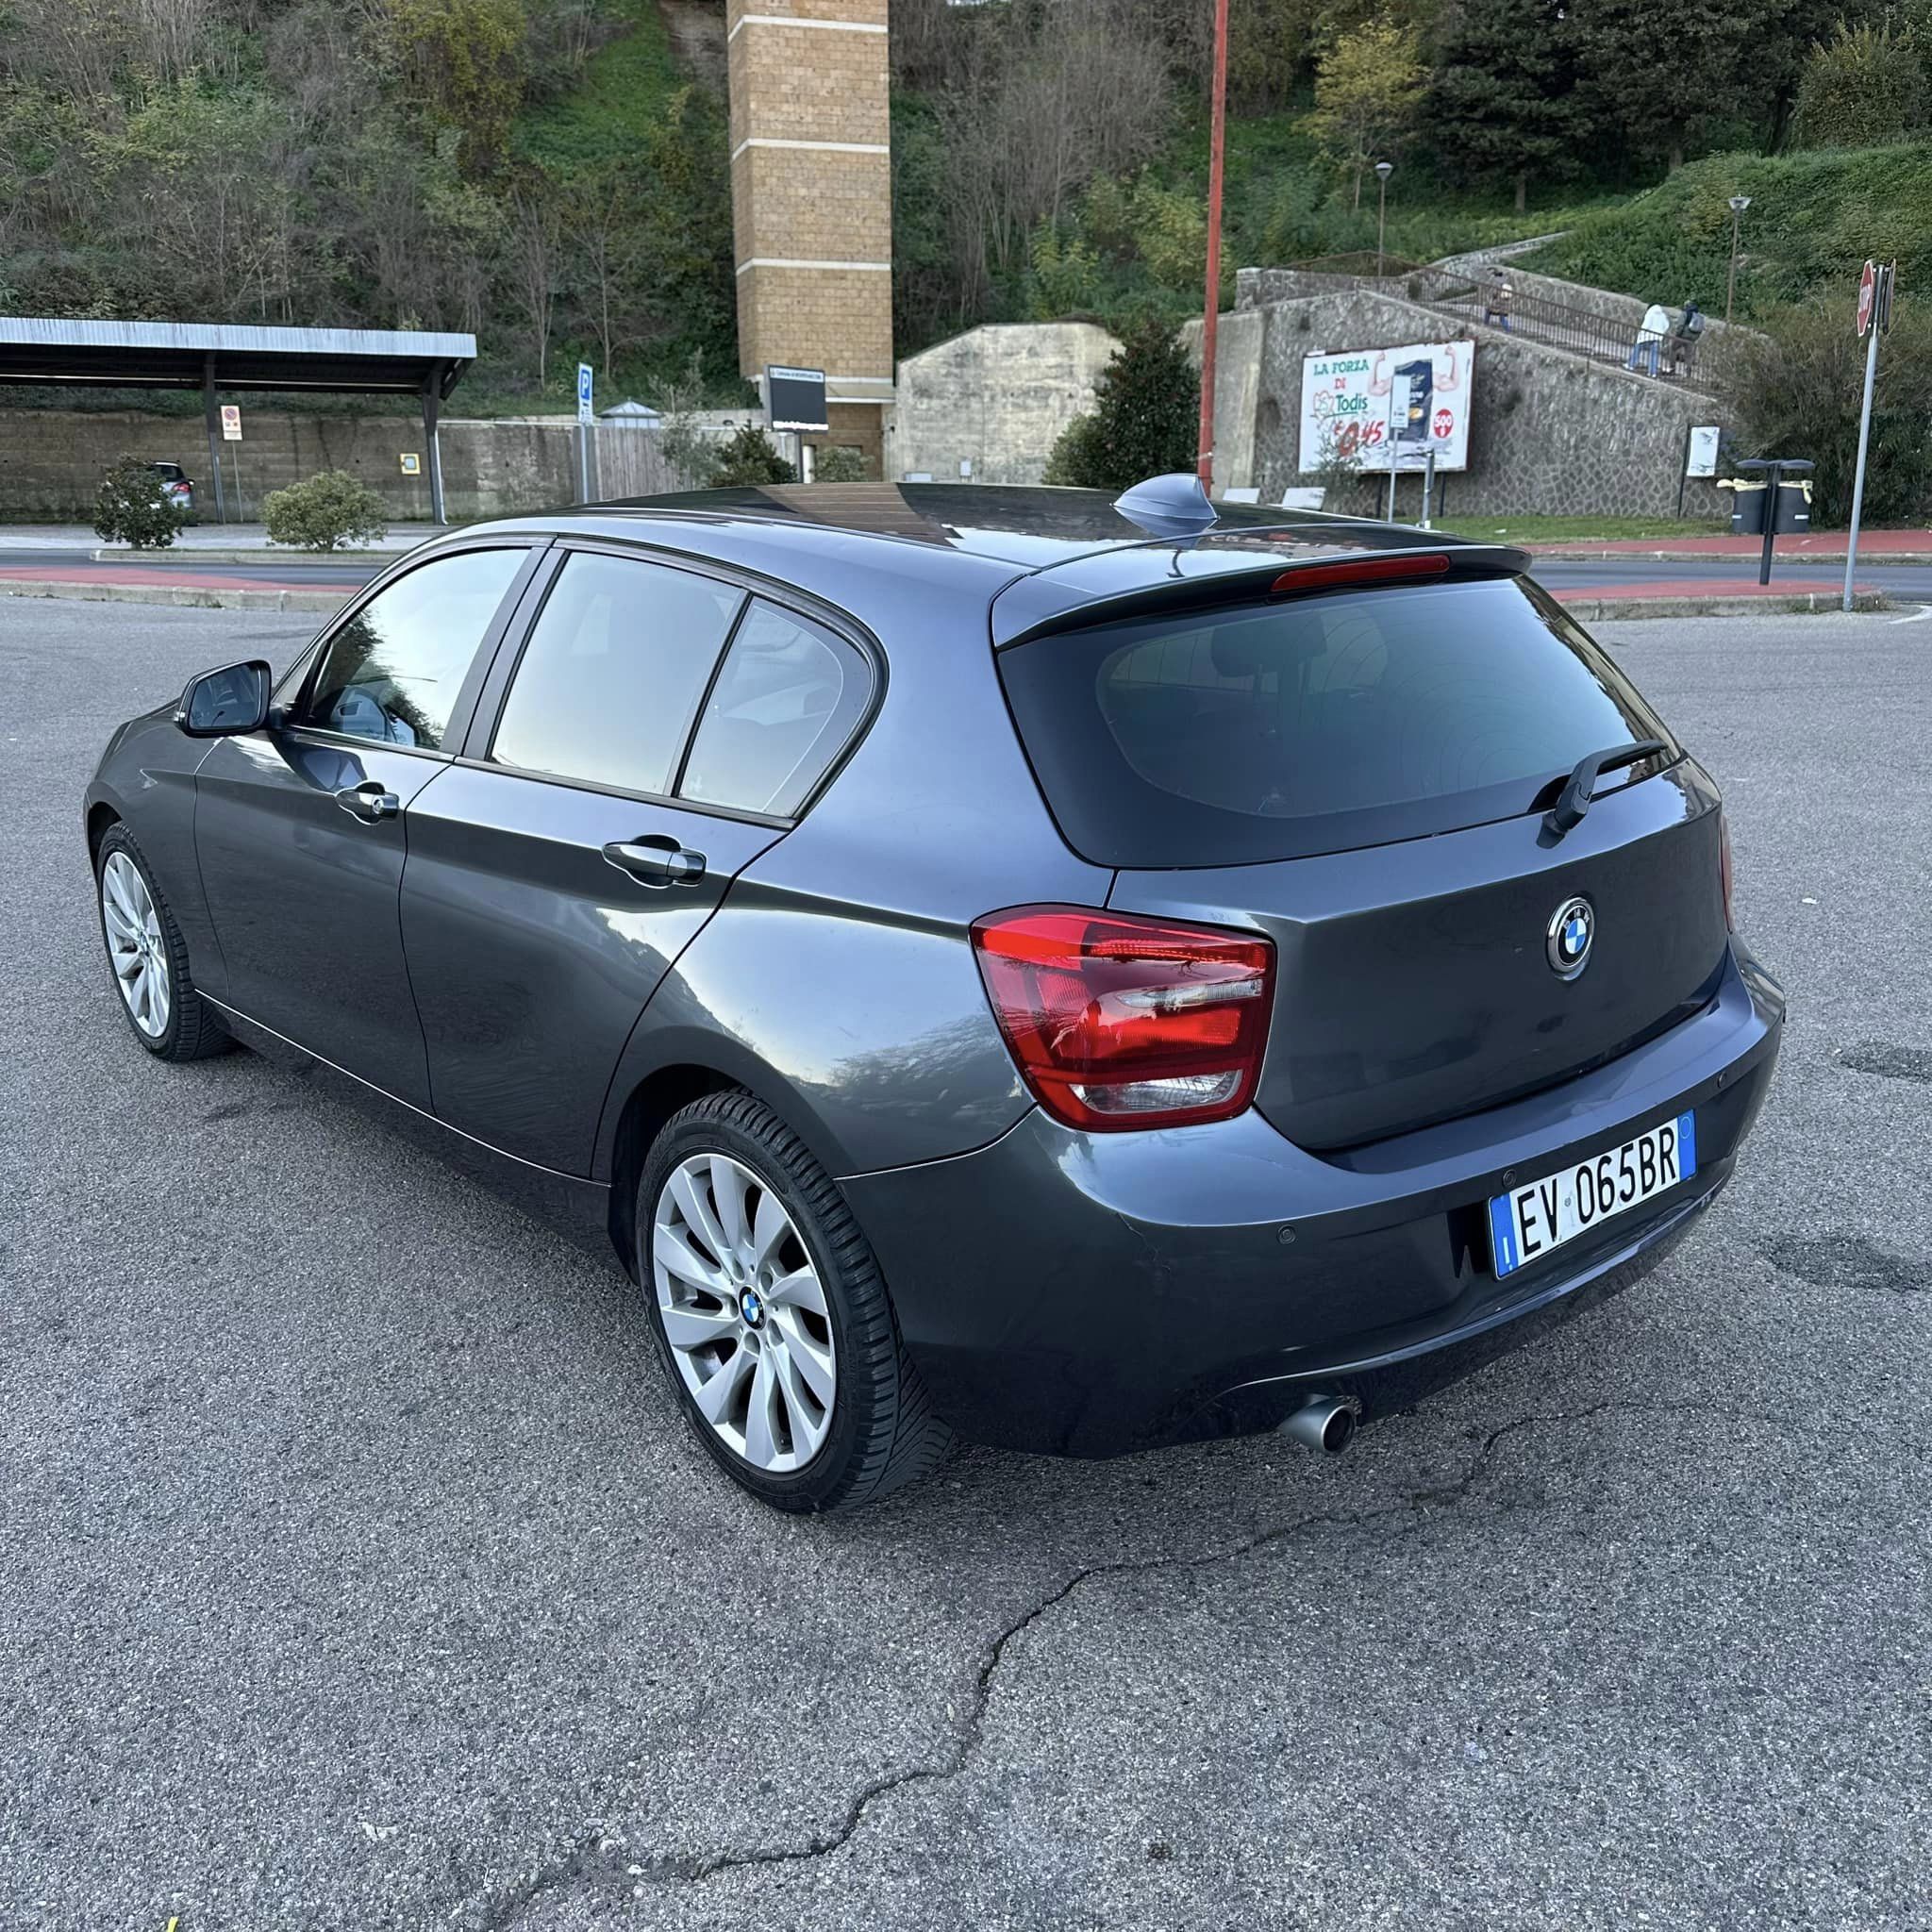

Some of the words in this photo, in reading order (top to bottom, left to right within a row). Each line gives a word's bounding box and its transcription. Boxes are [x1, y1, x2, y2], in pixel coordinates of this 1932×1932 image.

[1314, 364, 1328, 375] LA
[1332, 359, 1369, 374] FORZA
[1336, 393, 1368, 411] Todis
[1434, 415, 1453, 427] 500
[1563, 908, 1591, 929] BMW
[1517, 1178, 1557, 1257] EV
[1575, 1126, 1676, 1224] 065BR
